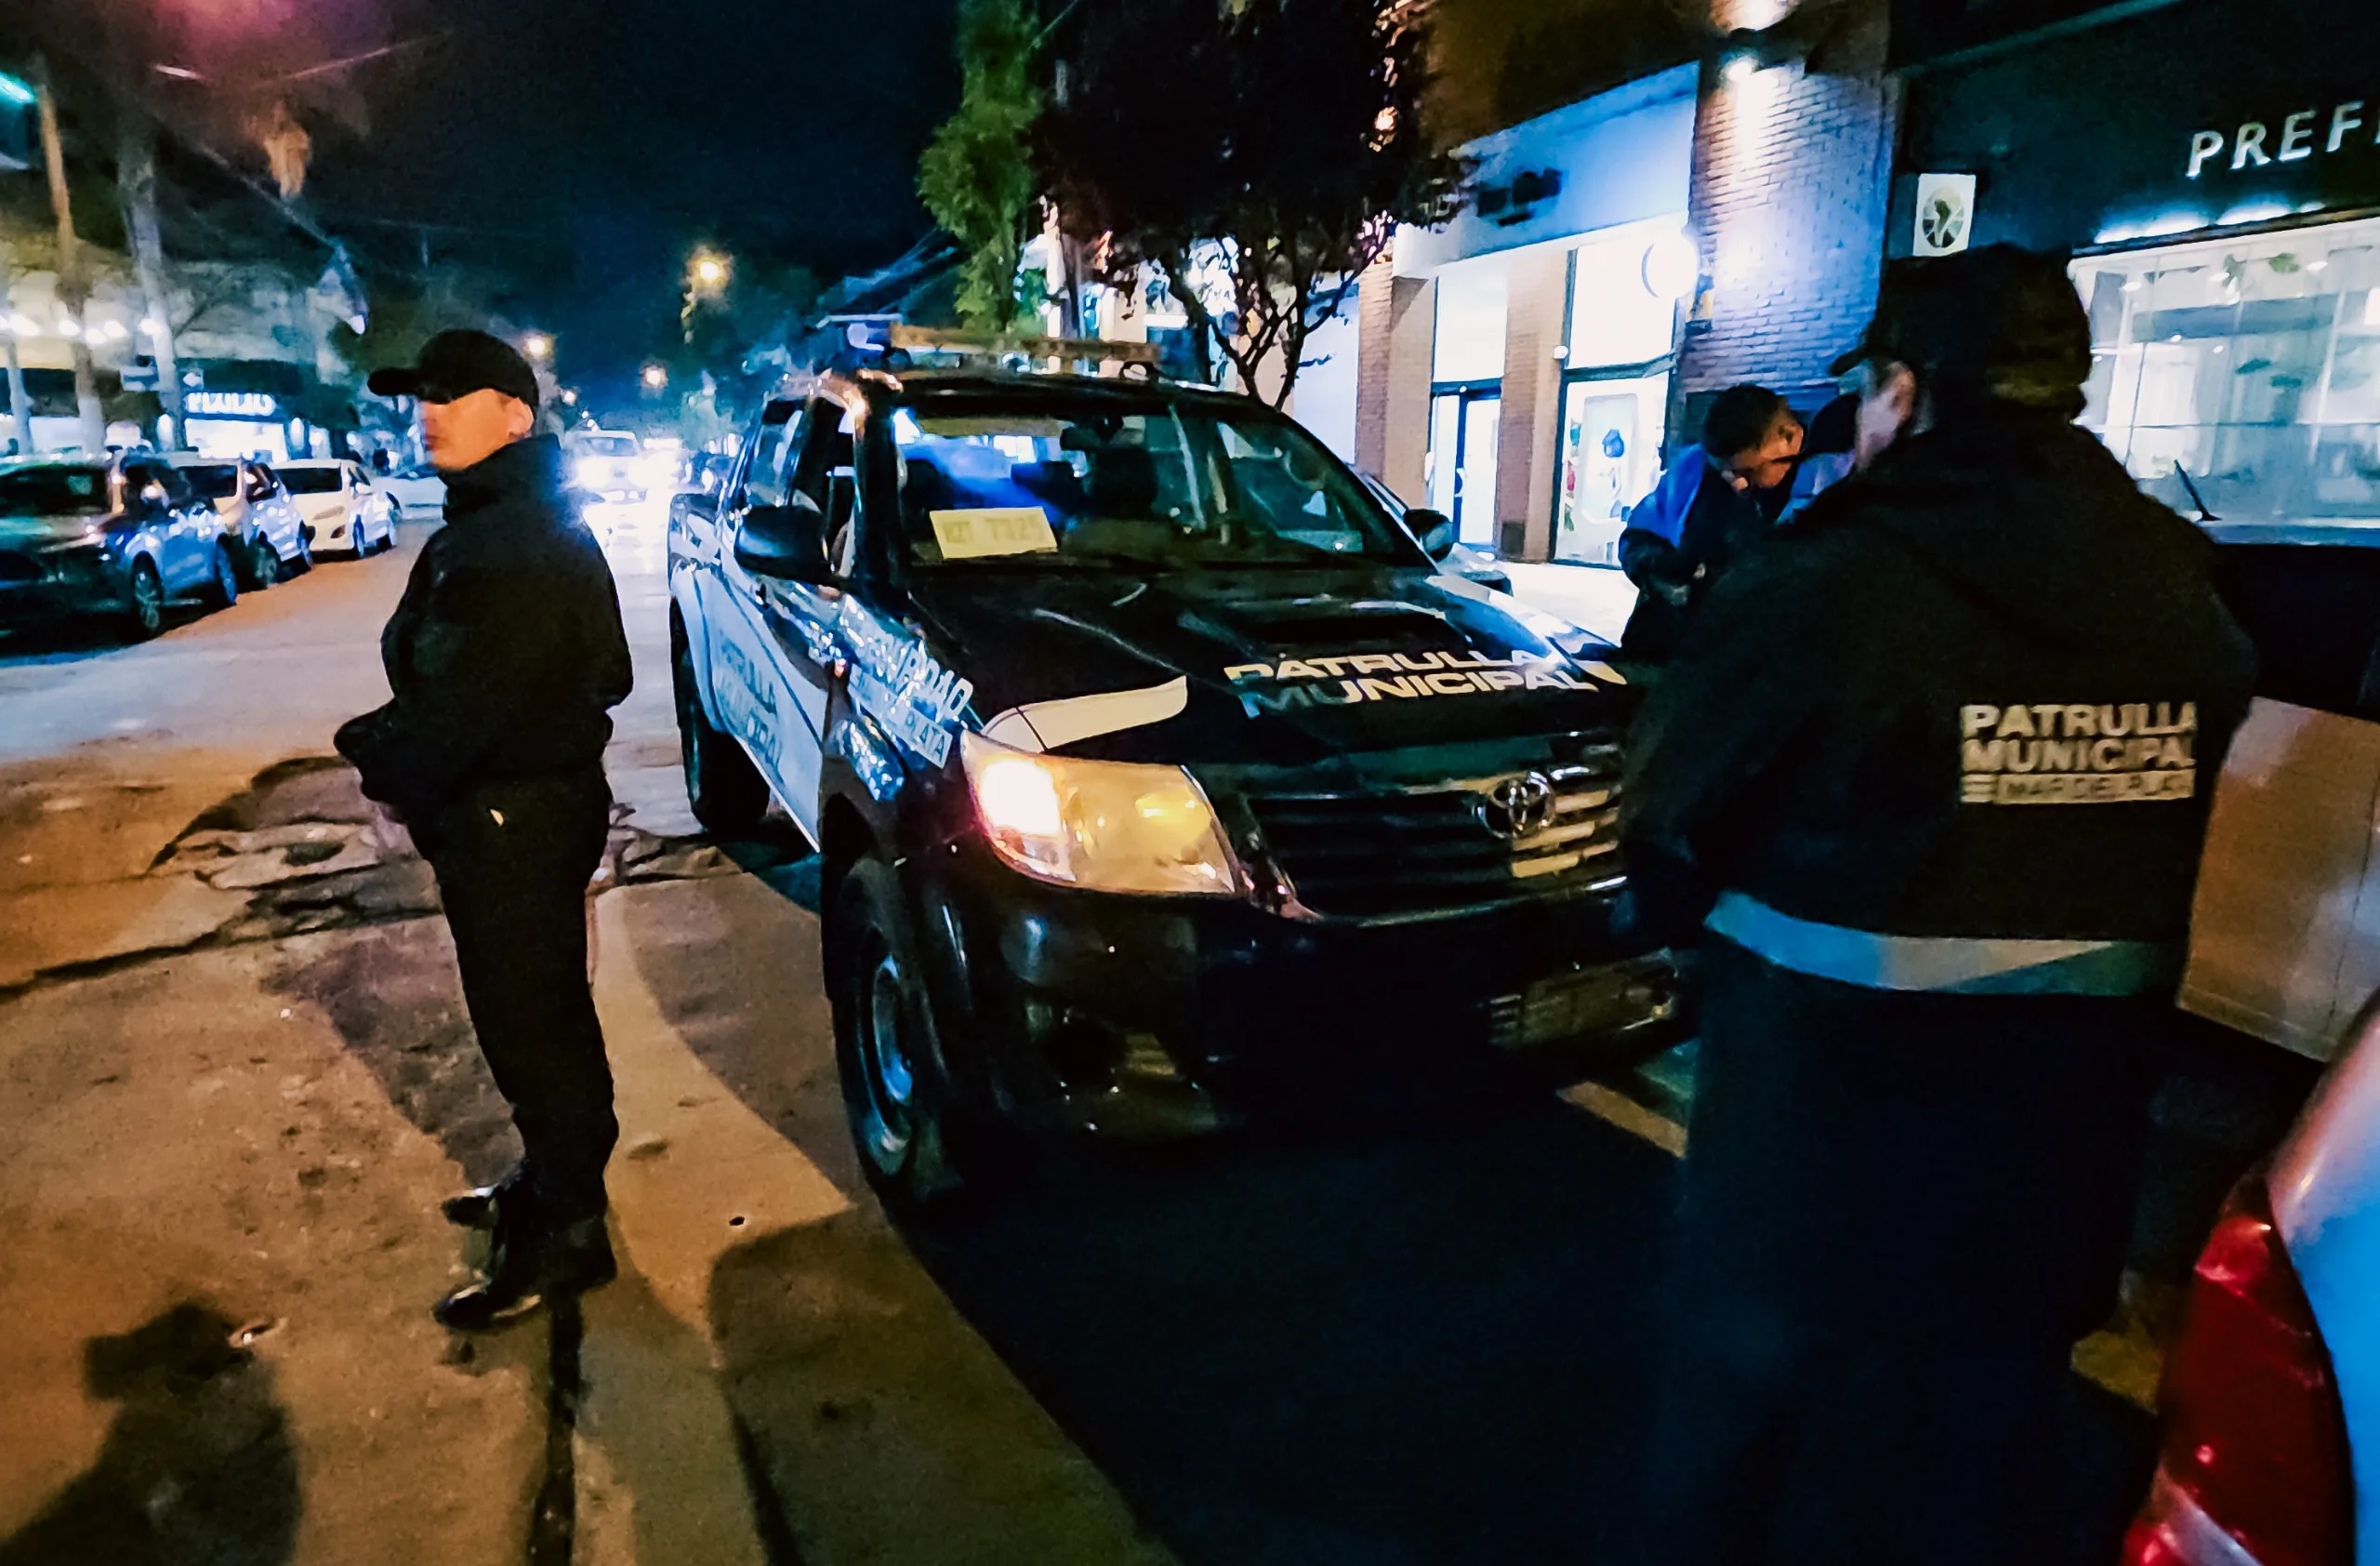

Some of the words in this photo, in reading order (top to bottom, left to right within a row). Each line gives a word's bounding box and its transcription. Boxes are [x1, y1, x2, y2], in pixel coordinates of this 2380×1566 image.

[2186, 100, 2380, 179] PREF
[1223, 651, 1571, 684] PATRULLA
[1237, 670, 1599, 719] MUNICIPAL
